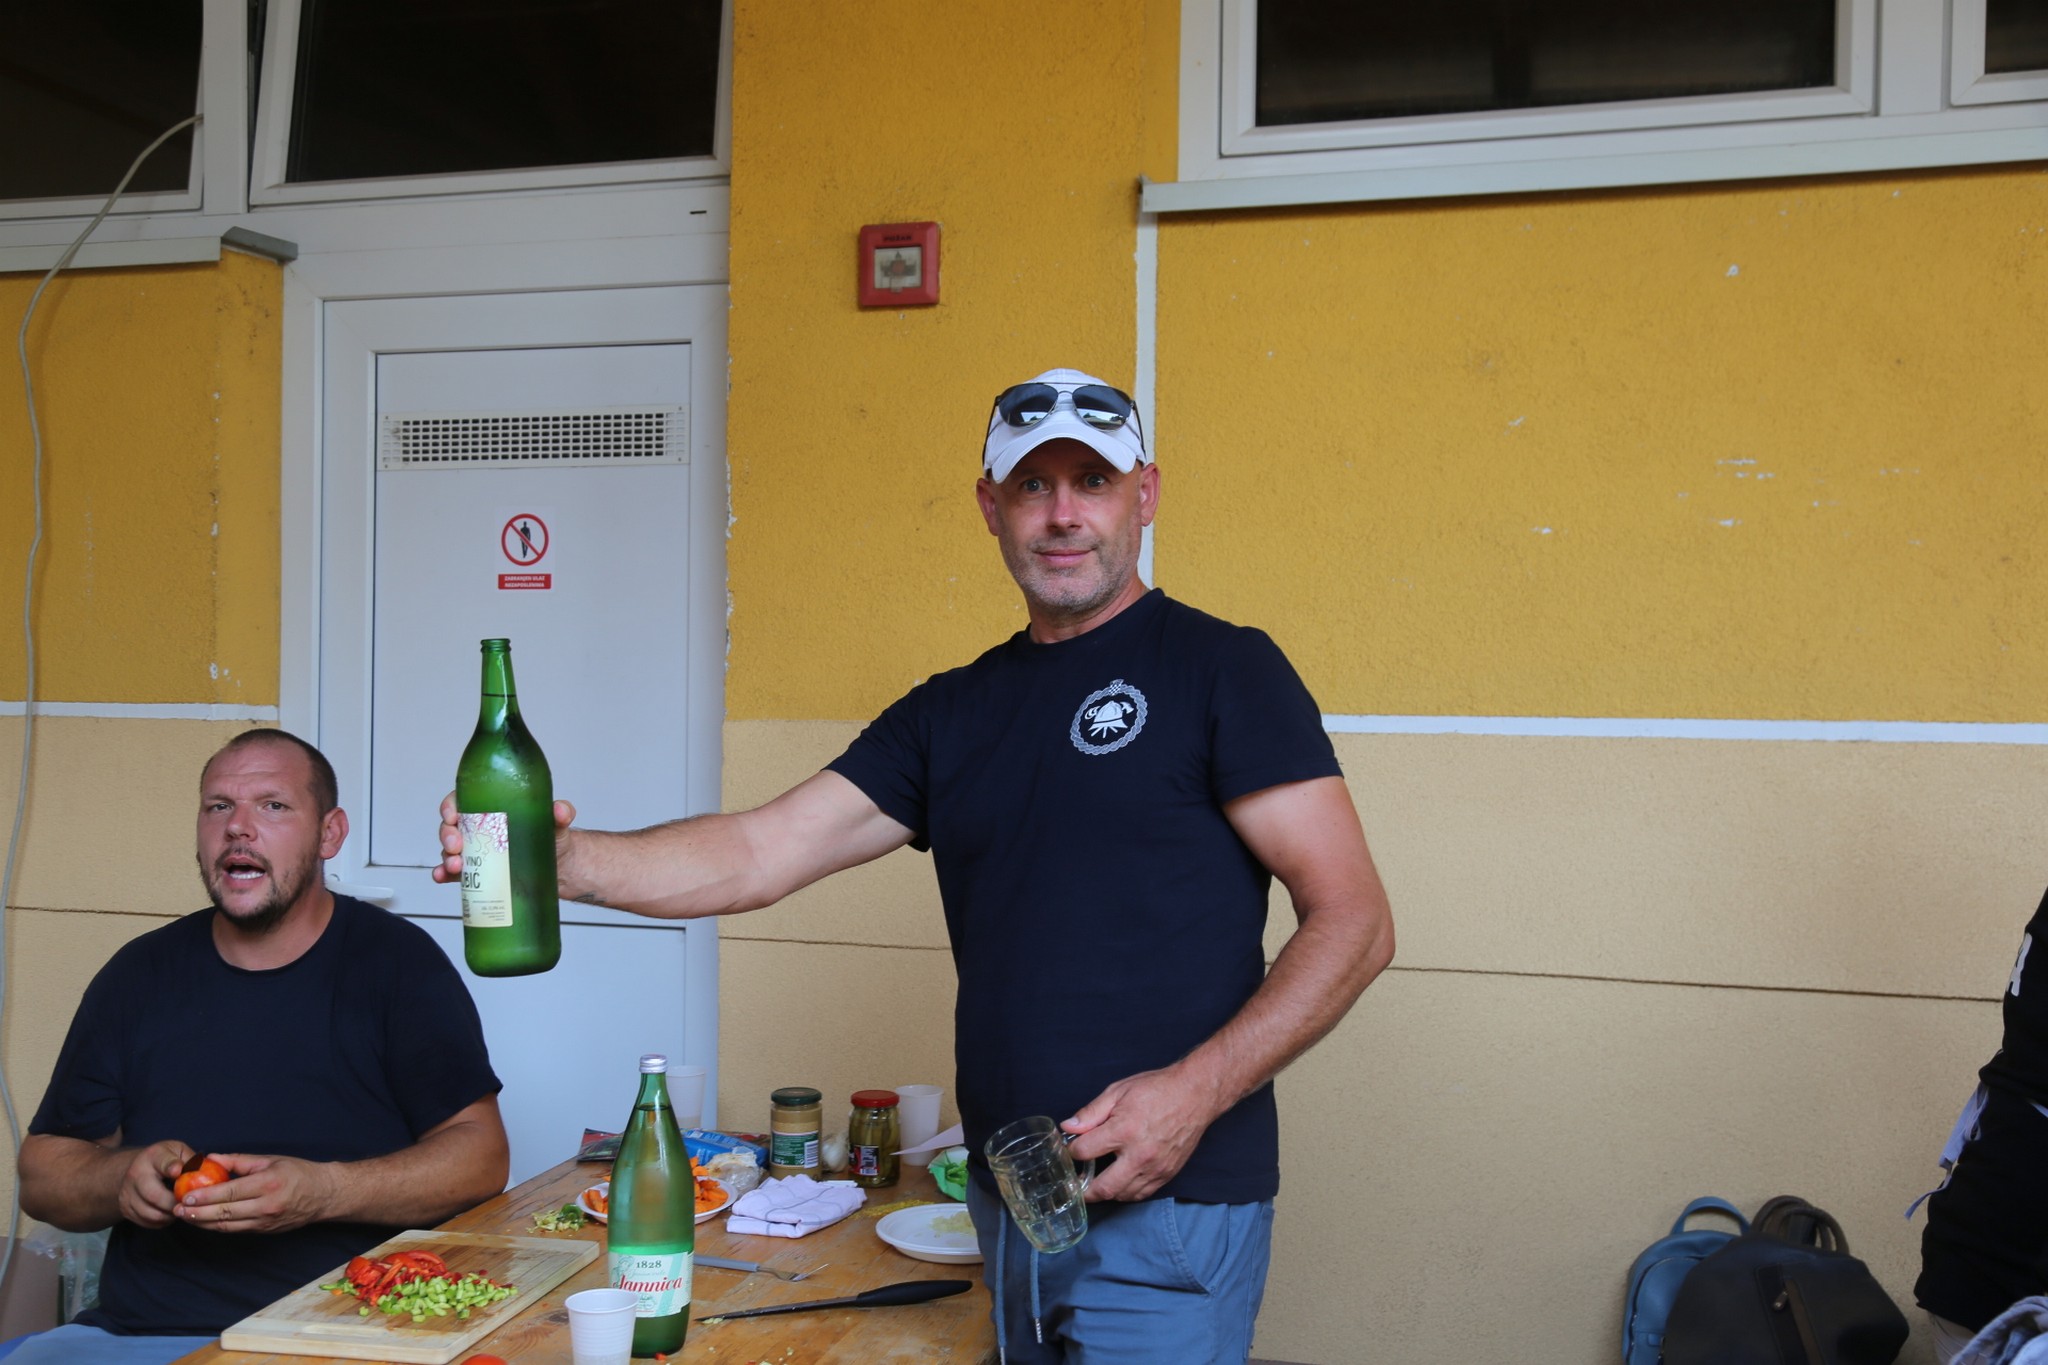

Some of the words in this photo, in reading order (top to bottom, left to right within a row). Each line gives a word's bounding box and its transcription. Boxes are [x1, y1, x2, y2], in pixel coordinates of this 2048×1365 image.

[466, 856, 482, 867] VINO
[636, 1260, 662, 1269] 1828
[612, 1274, 683, 1293] Jamnica
